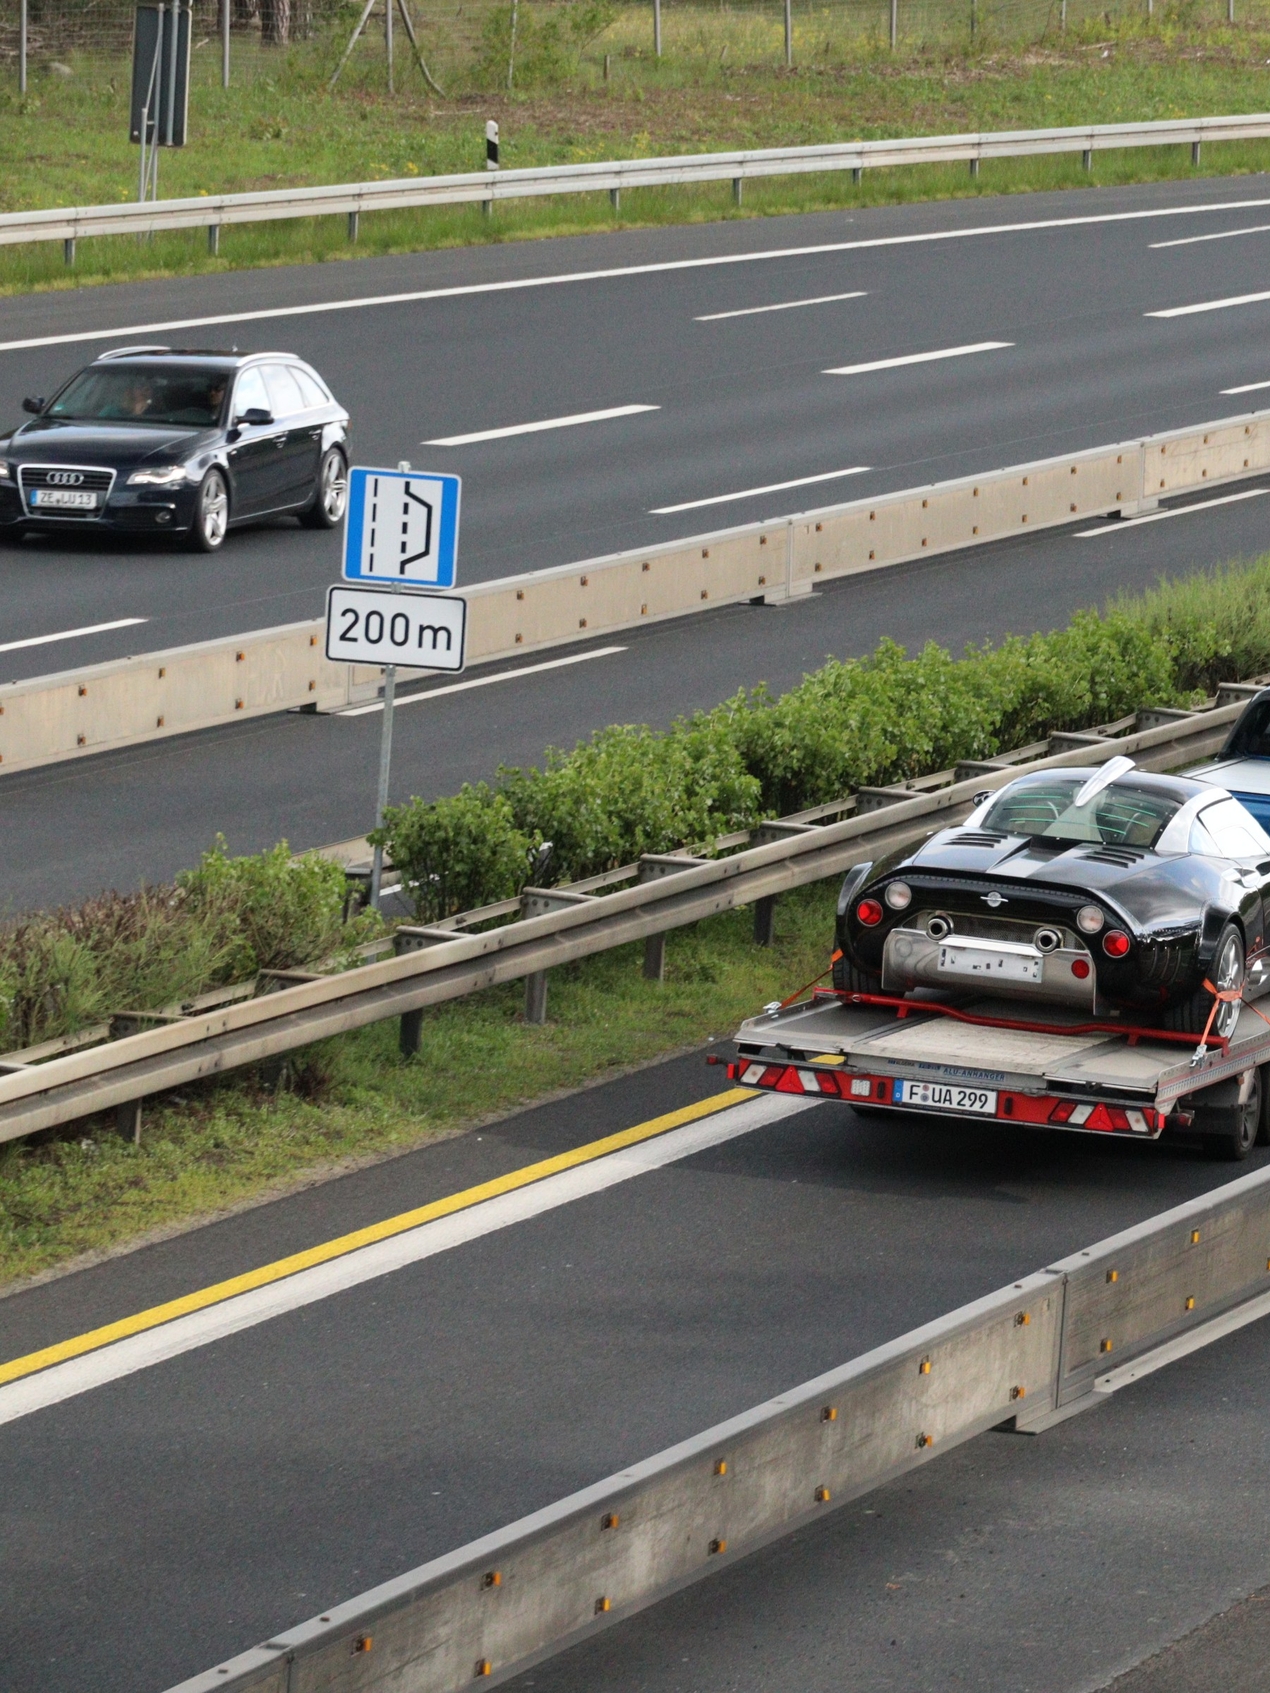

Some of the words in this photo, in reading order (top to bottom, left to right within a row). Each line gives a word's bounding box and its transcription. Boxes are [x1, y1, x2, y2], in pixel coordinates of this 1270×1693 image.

[40, 492, 54, 504] ZE
[78, 494, 92, 505] 13
[909, 1084, 921, 1100] F
[931, 1087, 953, 1106] UA
[957, 1090, 988, 1110] 299
